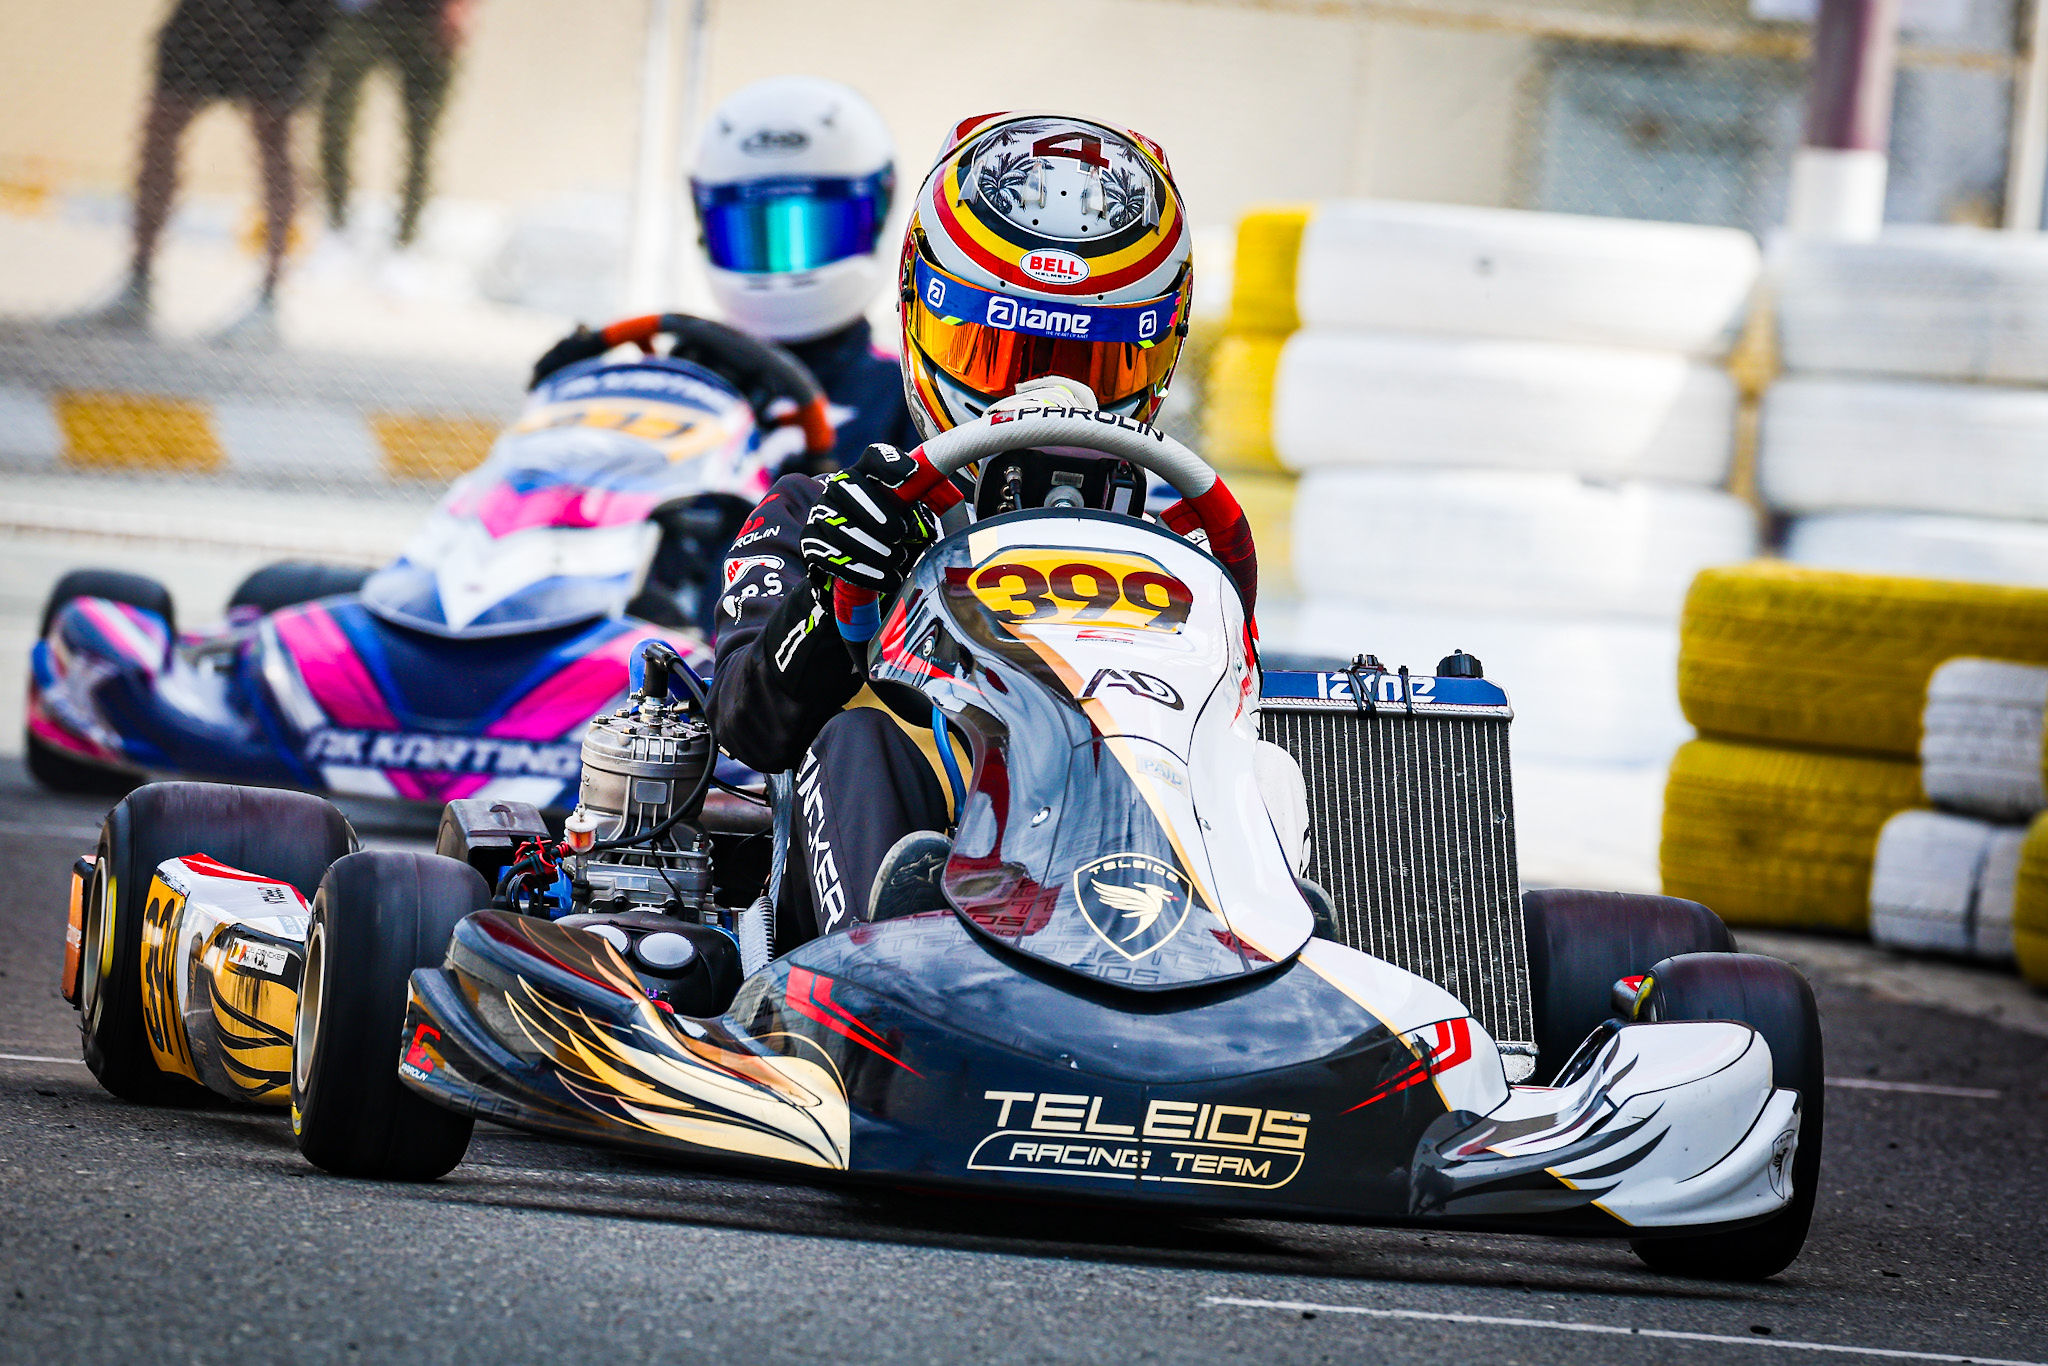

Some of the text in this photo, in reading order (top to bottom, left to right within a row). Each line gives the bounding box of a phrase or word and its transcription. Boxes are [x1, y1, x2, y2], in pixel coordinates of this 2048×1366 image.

[1031, 131, 1112, 175] 4
[1029, 256, 1079, 276] BELL
[1035, 271, 1072, 280] HELMETS
[1017, 405, 1165, 442] PAROLIN
[728, 525, 781, 553] ROLIN
[976, 563, 1194, 634] 399
[1088, 859, 1180, 884] TELEIOS
[984, 1090, 1311, 1149] TELEIOS
[1008, 1142, 1272, 1179] RACING TEAM
